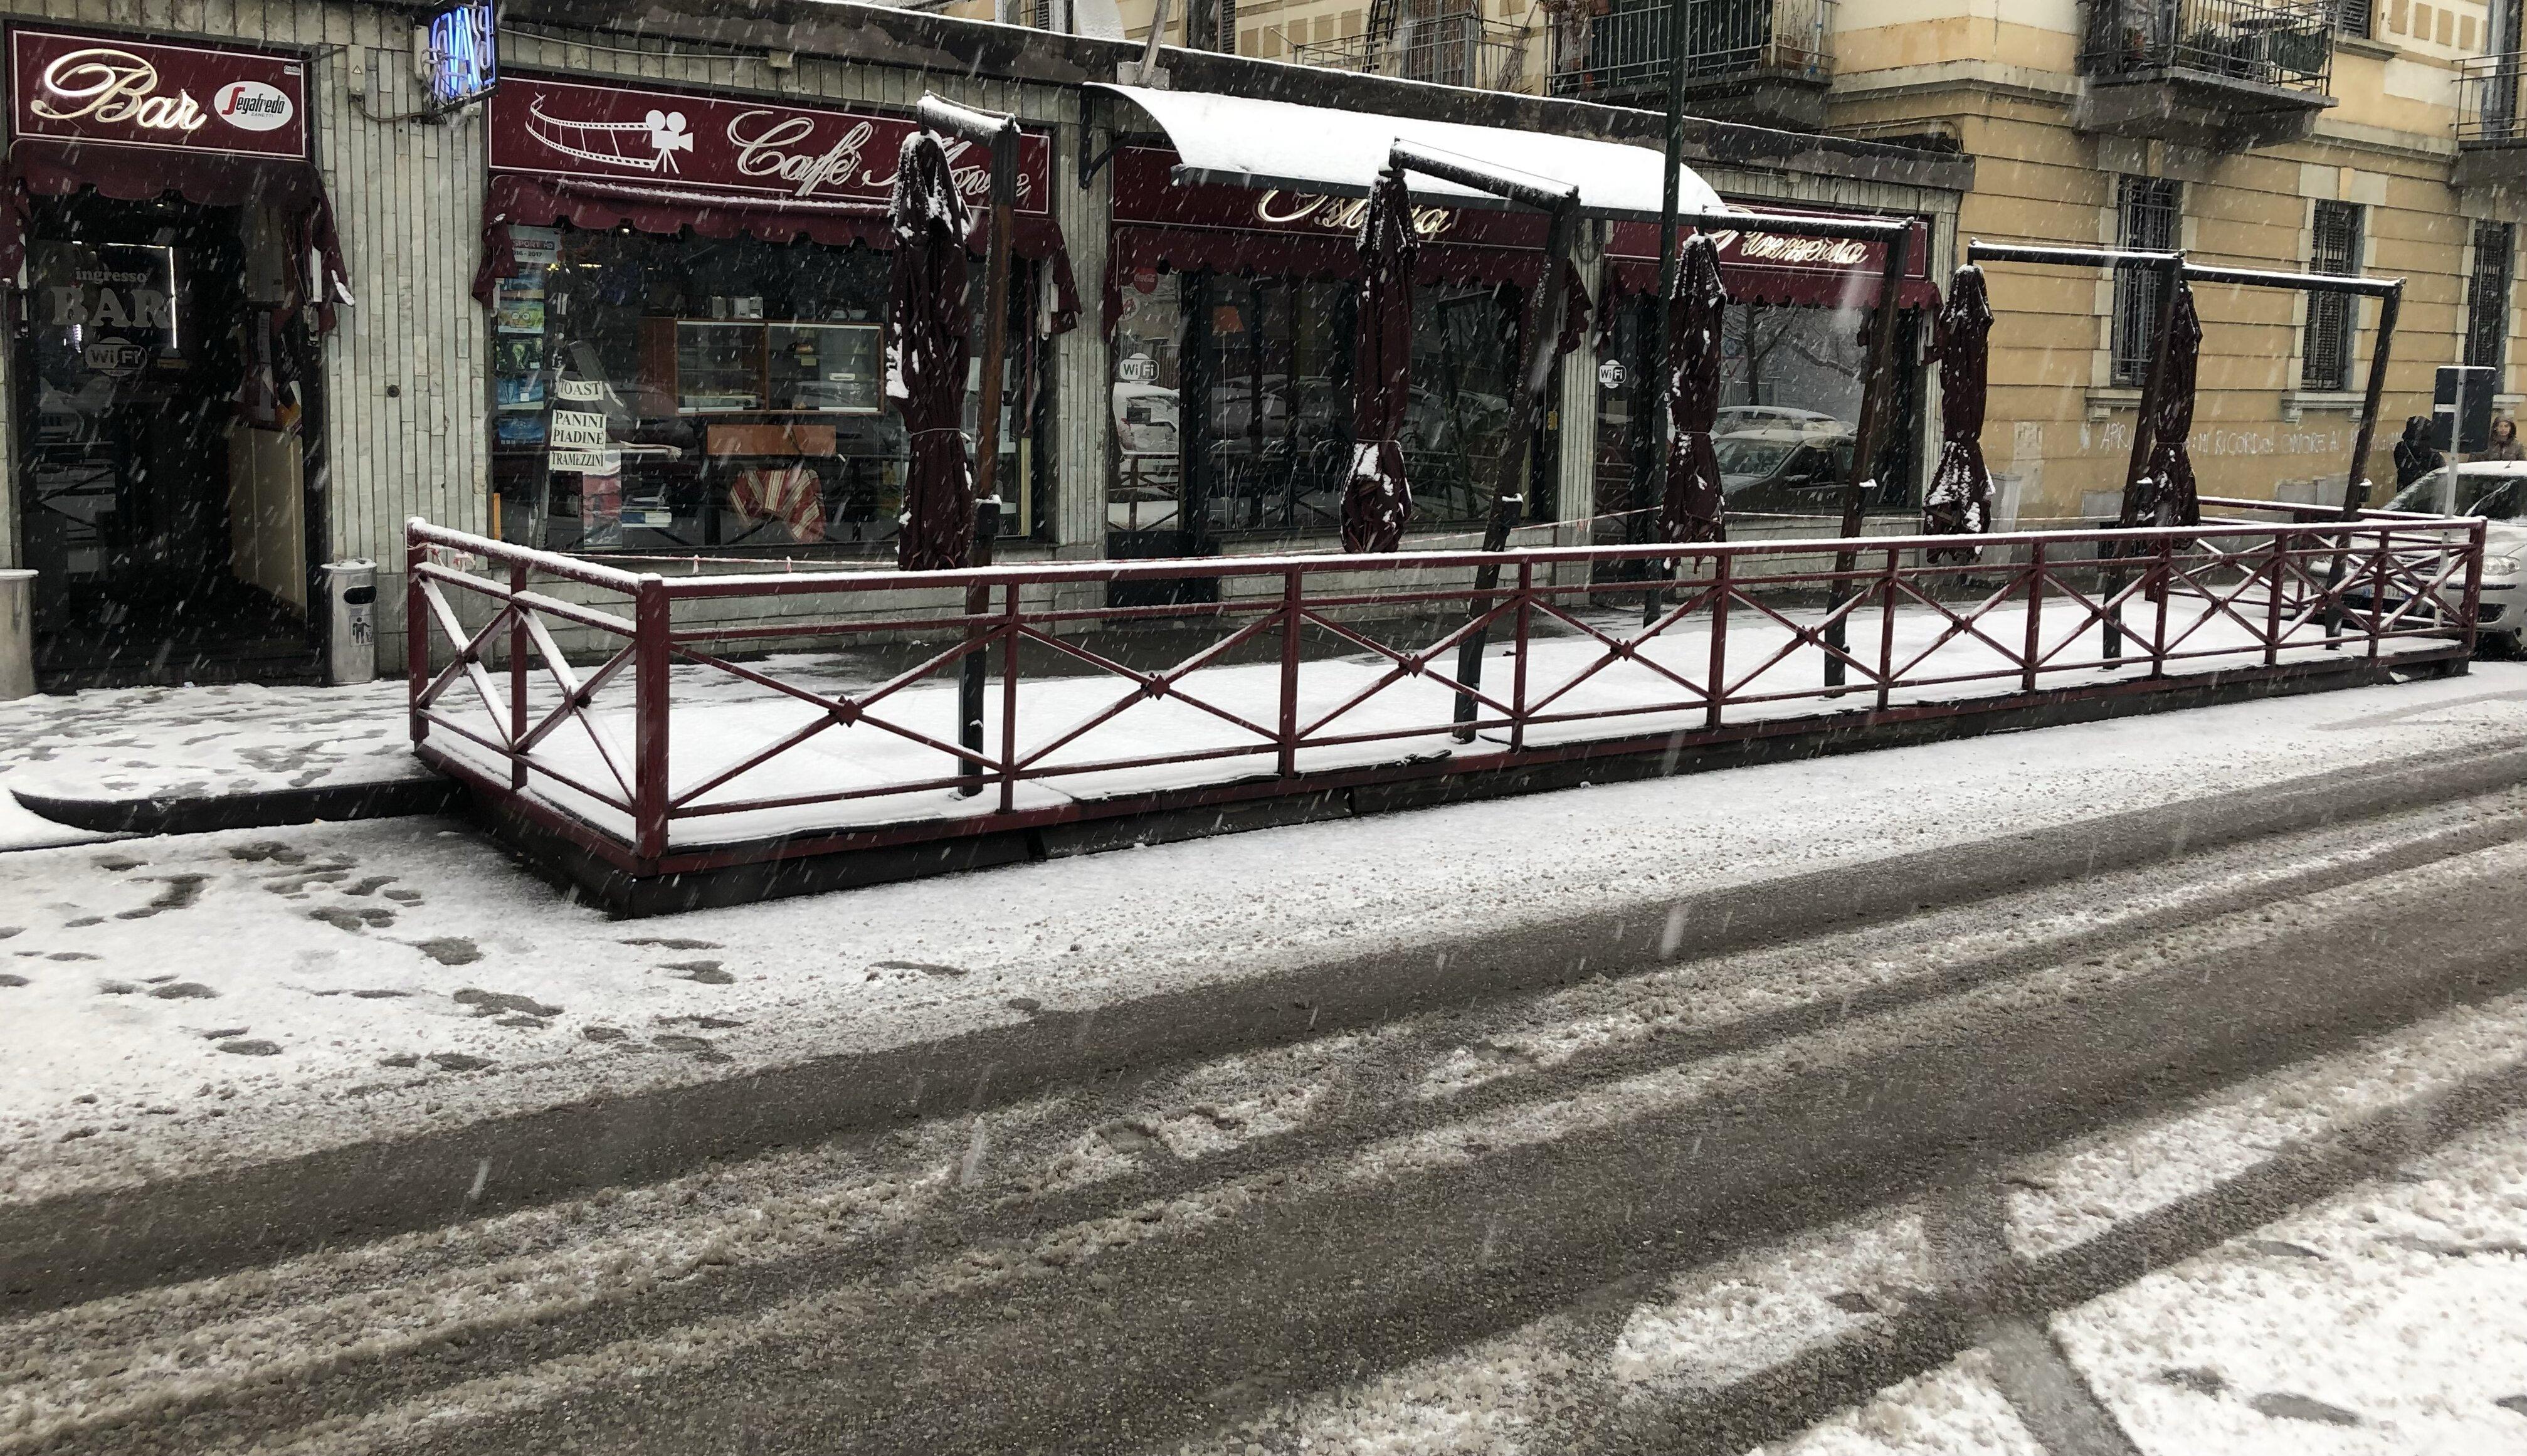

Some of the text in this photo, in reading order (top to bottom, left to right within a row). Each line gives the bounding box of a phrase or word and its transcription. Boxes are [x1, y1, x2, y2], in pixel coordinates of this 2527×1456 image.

[30, 48, 208, 130] Bar
[221, 86, 286, 115] Segafredo
[513, 240, 541, 249] SPORT
[75, 266, 148, 284] ingresso
[50, 286, 172, 329] BAR
[1123, 363, 1154, 376] WiFi
[1600, 368, 1623, 379] WiFi
[560, 380, 601, 396] TOAST
[555, 411, 604, 428] PANINI
[553, 428, 604, 445] PIADINE
[552, 452, 604, 467] TRAMEZZINI
